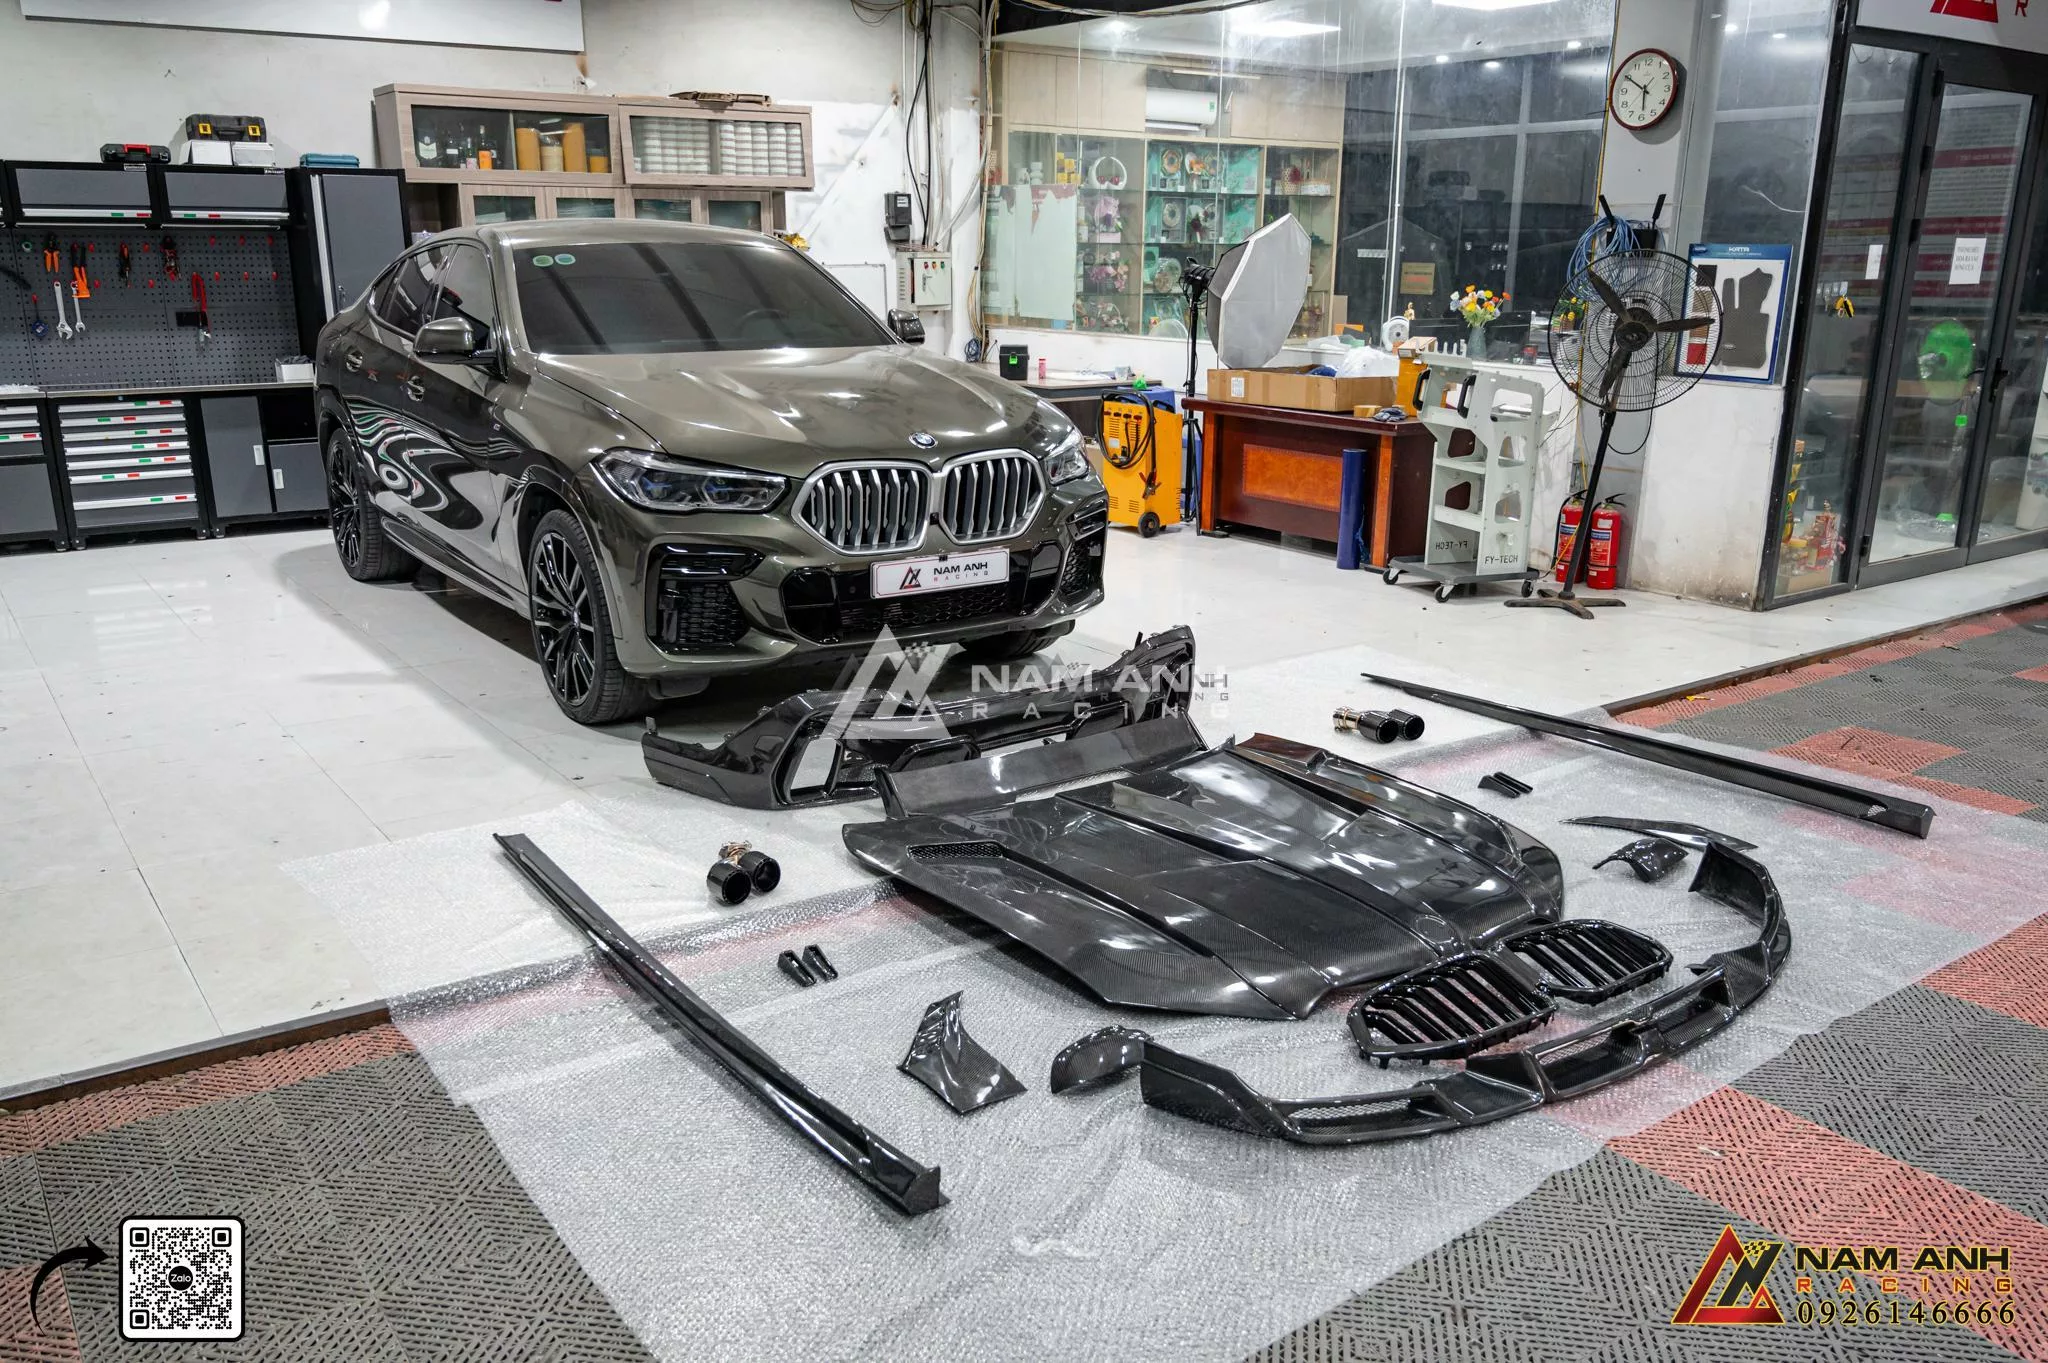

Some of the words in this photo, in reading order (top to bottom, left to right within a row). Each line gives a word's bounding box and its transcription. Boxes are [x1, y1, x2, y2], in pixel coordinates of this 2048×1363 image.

[1644, 58, 1654, 66] 12
[1634, 63, 1641, 71] 11
[1662, 72, 1670, 80] 2
[1620, 87, 1628, 96] 9
[1664, 85, 1671, 93] 3
[1621, 100, 1629, 109] 8
[1659, 98, 1666, 106] 4
[1628, 110, 1635, 118] 7
[1637, 113, 1645, 121] 6
[1650, 109, 1657, 117] 5
[1484, 555, 1519, 565] FY-TECH
[933, 565, 961, 576] NAM
[963, 561, 988, 572] ANH
[933, 570, 989, 583] RACING
